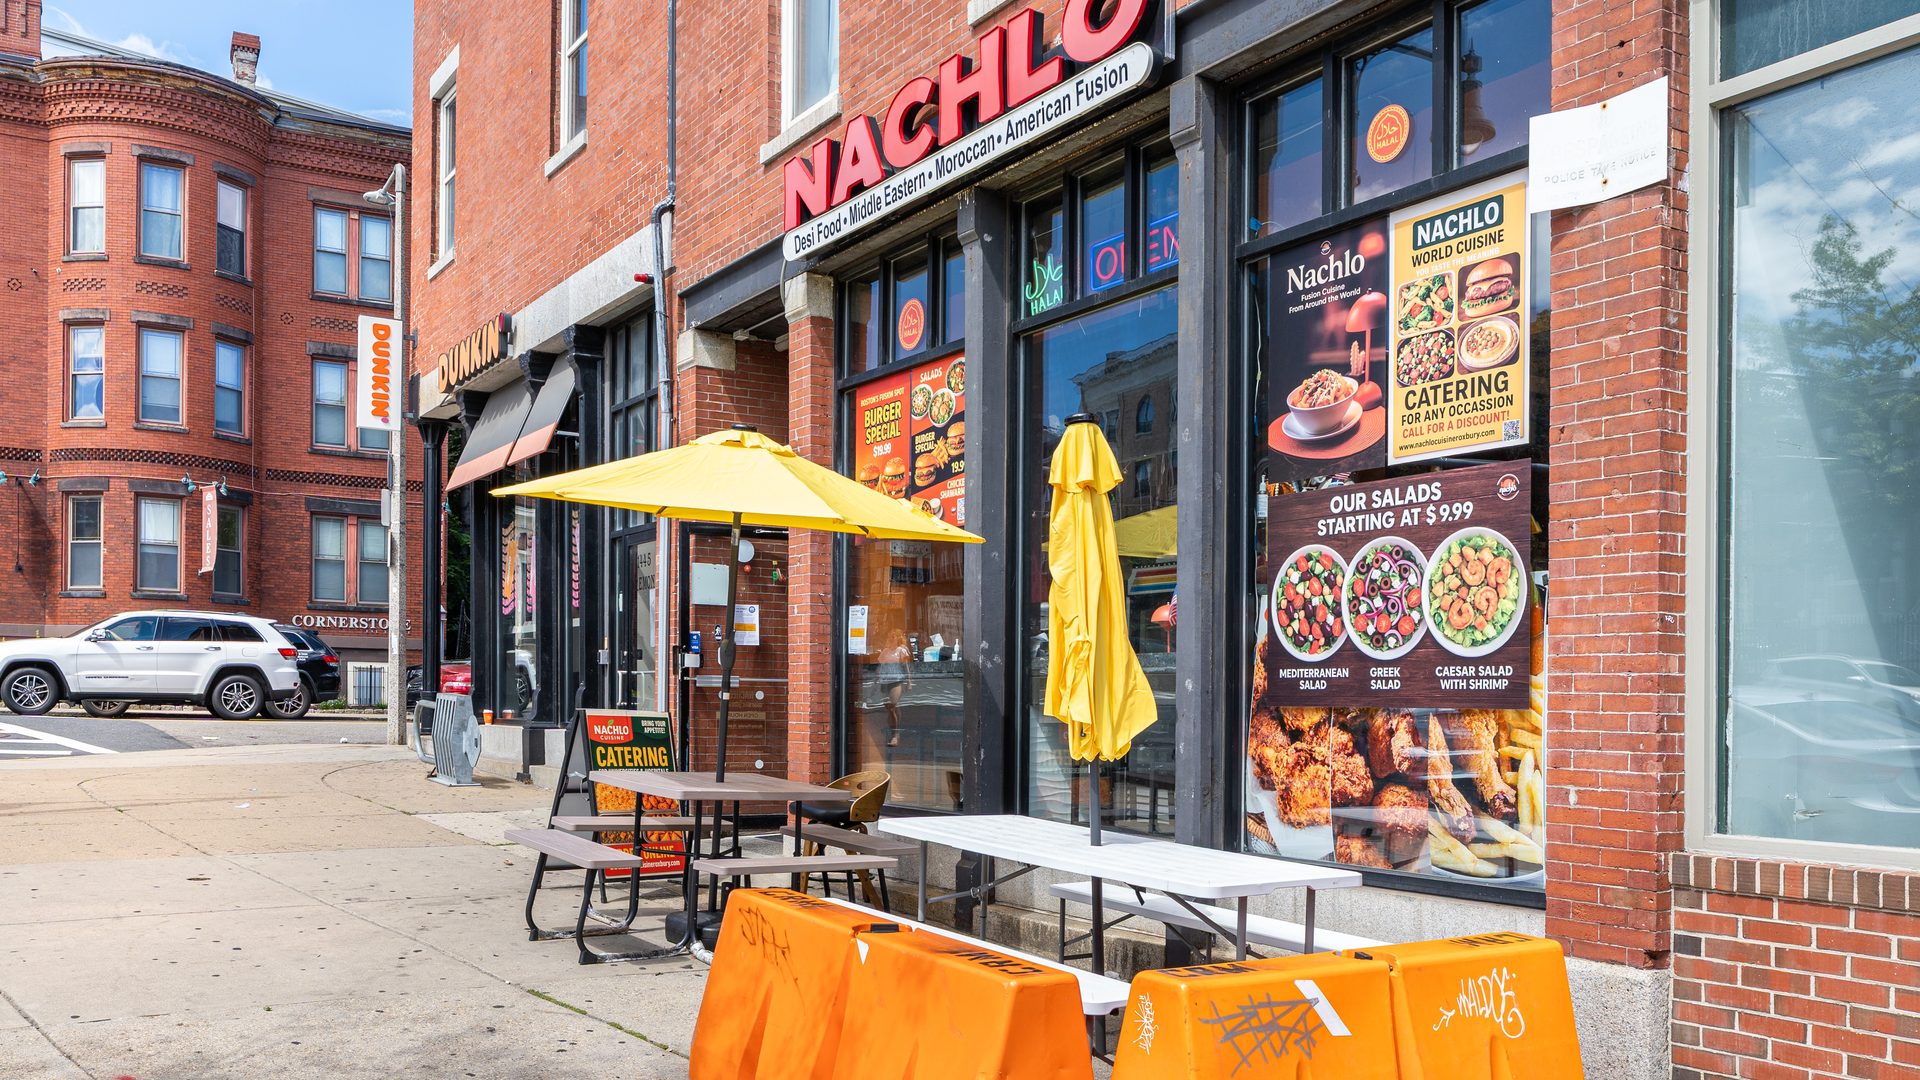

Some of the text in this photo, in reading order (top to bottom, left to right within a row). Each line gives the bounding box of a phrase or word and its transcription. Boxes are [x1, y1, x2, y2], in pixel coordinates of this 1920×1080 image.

[784, 0, 1145, 231] NACHLO
[1377, 135, 1398, 149] HALAL
[794, 62, 1128, 254] Desi Food Middle Eastern Moroccan American Fusion
[1544, 169, 1585, 185] POLICE
[1621, 146, 1656, 167] NOTICE
[1417, 201, 1499, 246] NACHLO
[1412, 229, 1504, 267] WORLD CUISINE
[1287, 249, 1365, 294] Nachlo
[1289, 287, 1361, 314] From Around the World
[1301, 283, 1345, 301] Fusion Cuisine
[920, 368, 942, 383] SALADS
[1405, 371, 1509, 411] CATERING
[864, 400, 902, 428] BURGER
[1401, 394, 1514, 426] FOR ANY OCCASSION
[866, 419, 901, 445] SPECIAL
[1402, 410, 1510, 439] CALL FOR A DISCOUNT!
[915, 432, 935, 445] BURGER
[915, 441, 935, 454] SPECIAL
[1399, 428, 1495, 451] www.nachlocuisineroxbury.com
[873, 443, 891, 458] $19.99
[1330, 482, 1442, 513] OUR SALADS
[1318, 514, 1395, 536] STARTING
[1400, 508, 1421, 527] AT
[292, 614, 411, 631] CORNERSTOE
[1279, 668, 1349, 679] MEDITERRANEAN
[1370, 667, 1401, 678] GREEK
[1435, 665, 1513, 677] CAESAR SALAD
[1299, 680, 1327, 690] SALAD
[1370, 679, 1401, 690] SALAD
[1440, 679, 1509, 690] WITH SHRIMP
[594, 725, 629, 735] NACHLO
[596, 746, 668, 767] CATERING
